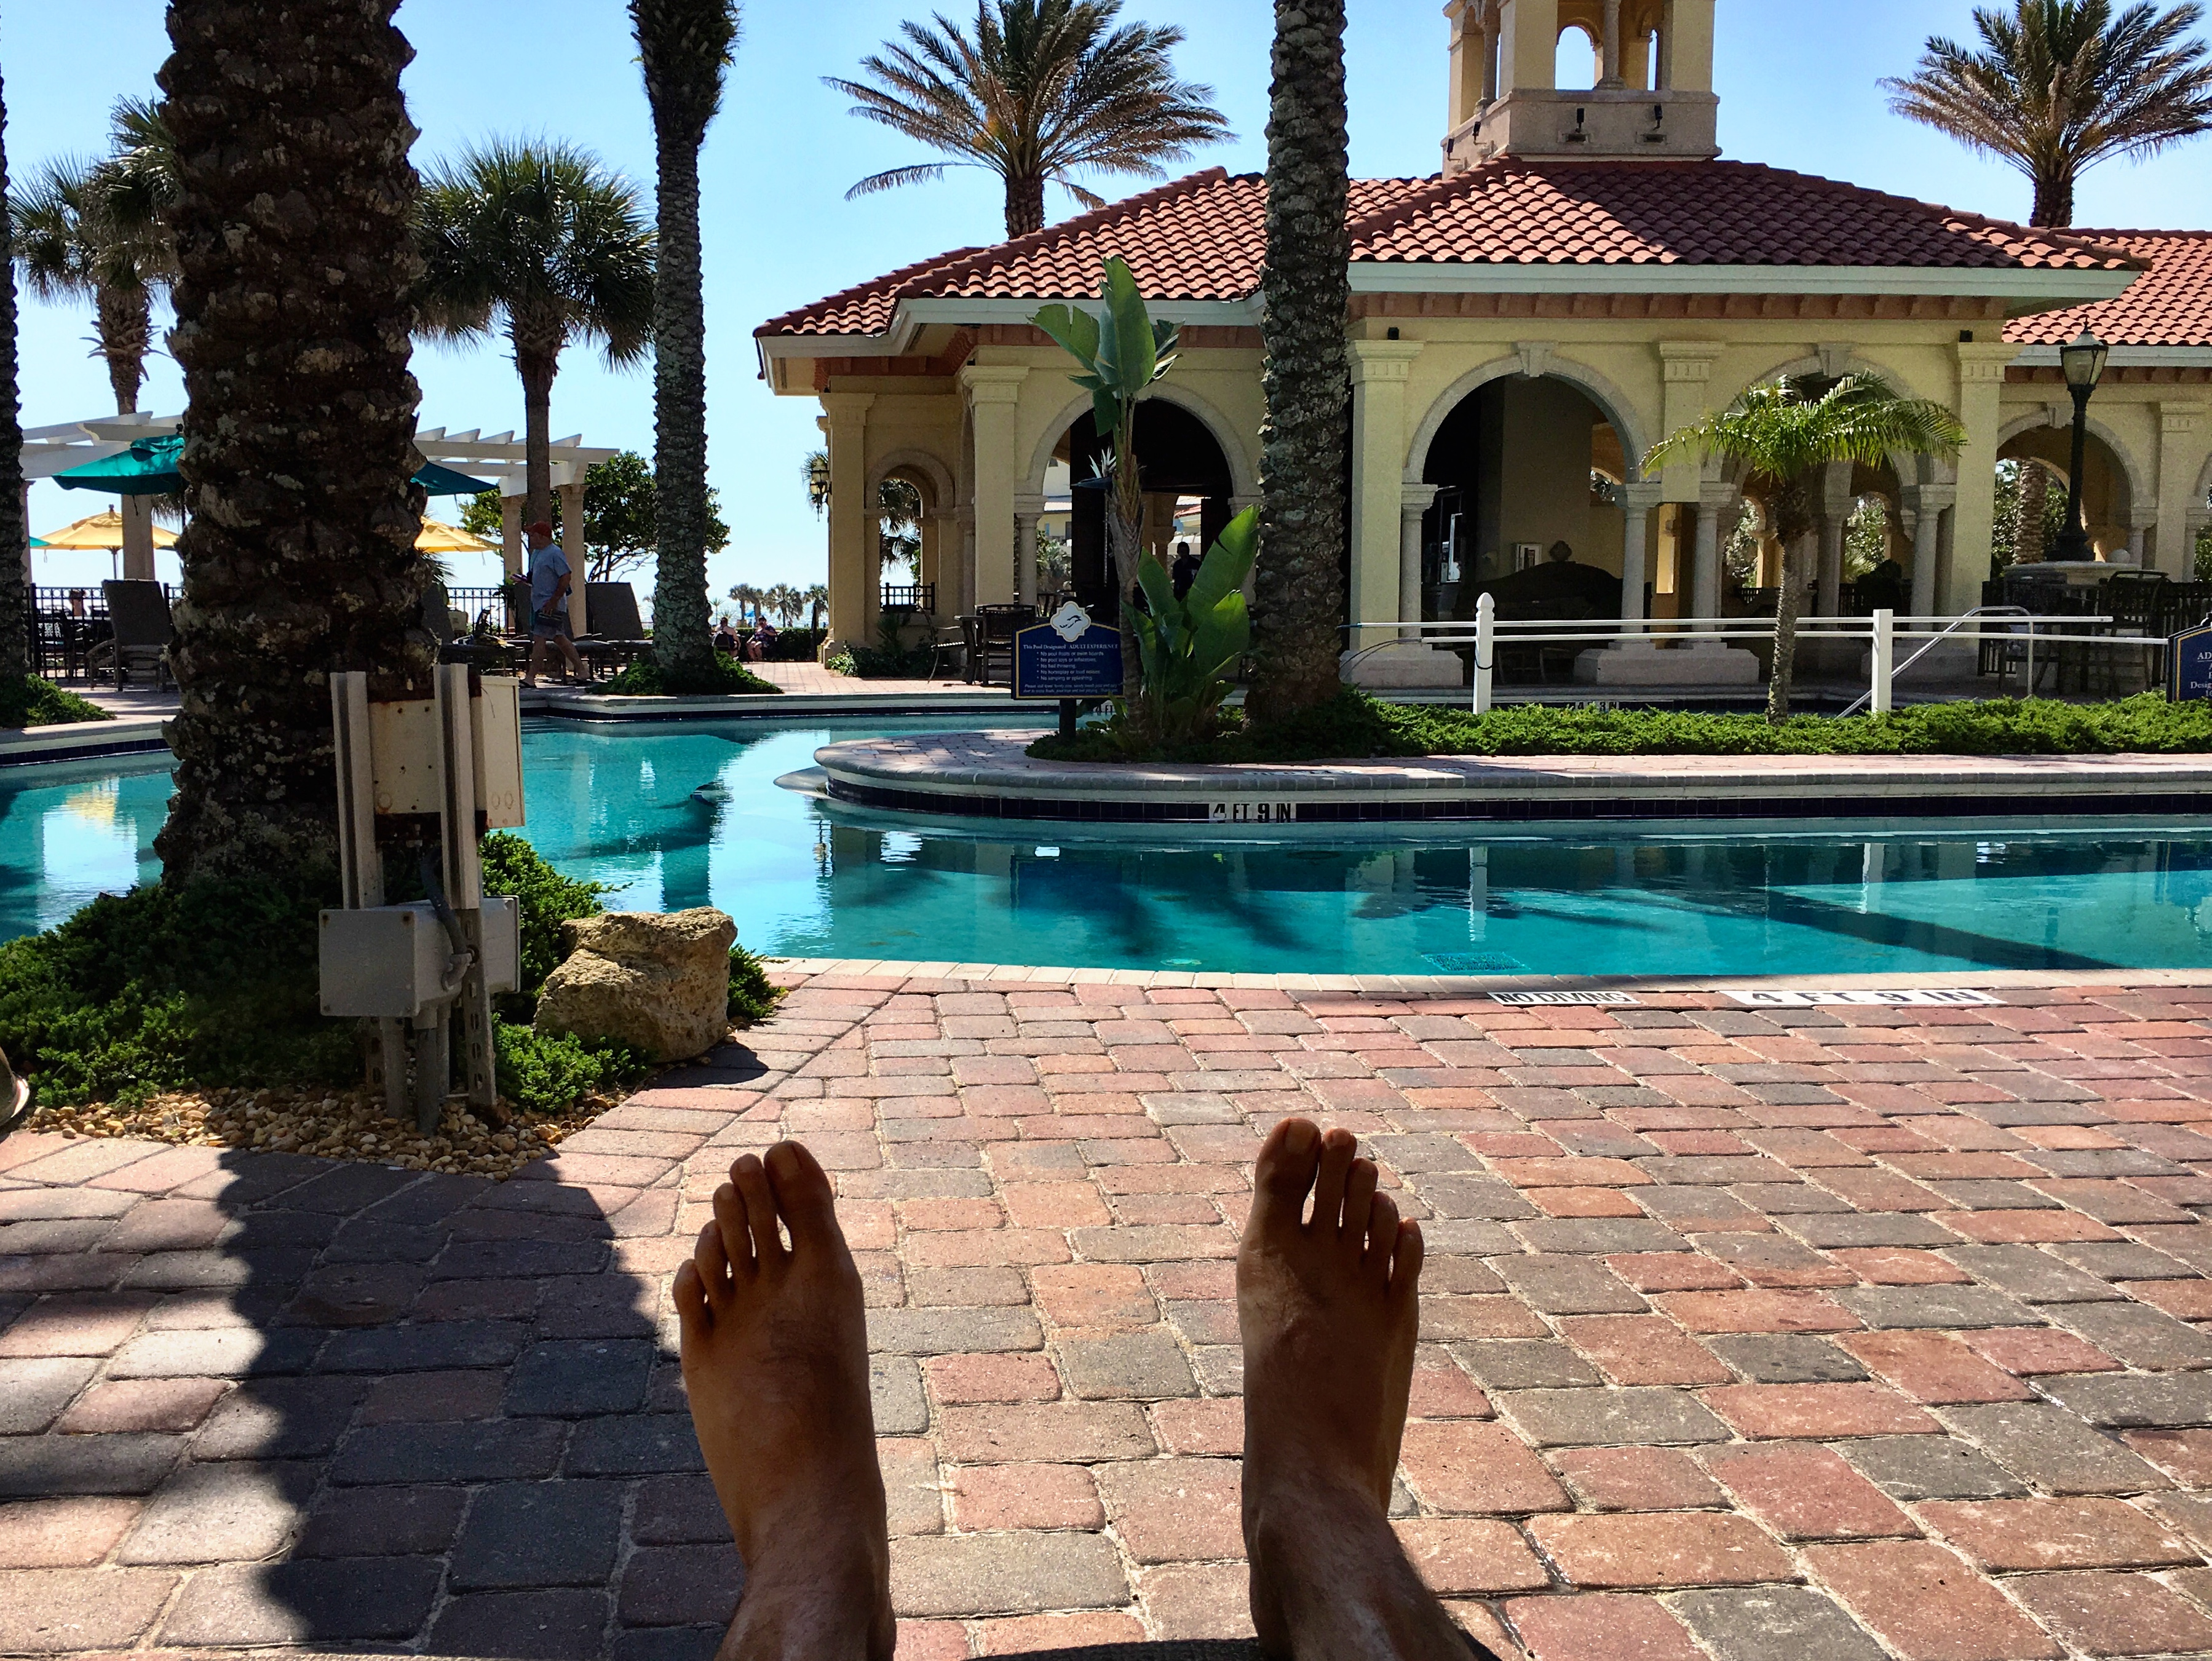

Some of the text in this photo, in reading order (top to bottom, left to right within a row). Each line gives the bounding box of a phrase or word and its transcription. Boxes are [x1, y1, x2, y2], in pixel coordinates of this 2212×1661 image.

[1213, 803, 1291, 823] 4 FT 9 IN
[1493, 993, 1633, 1002] NO DIVING
[1752, 991, 1996, 1002] 4 FT. 9 IN.
